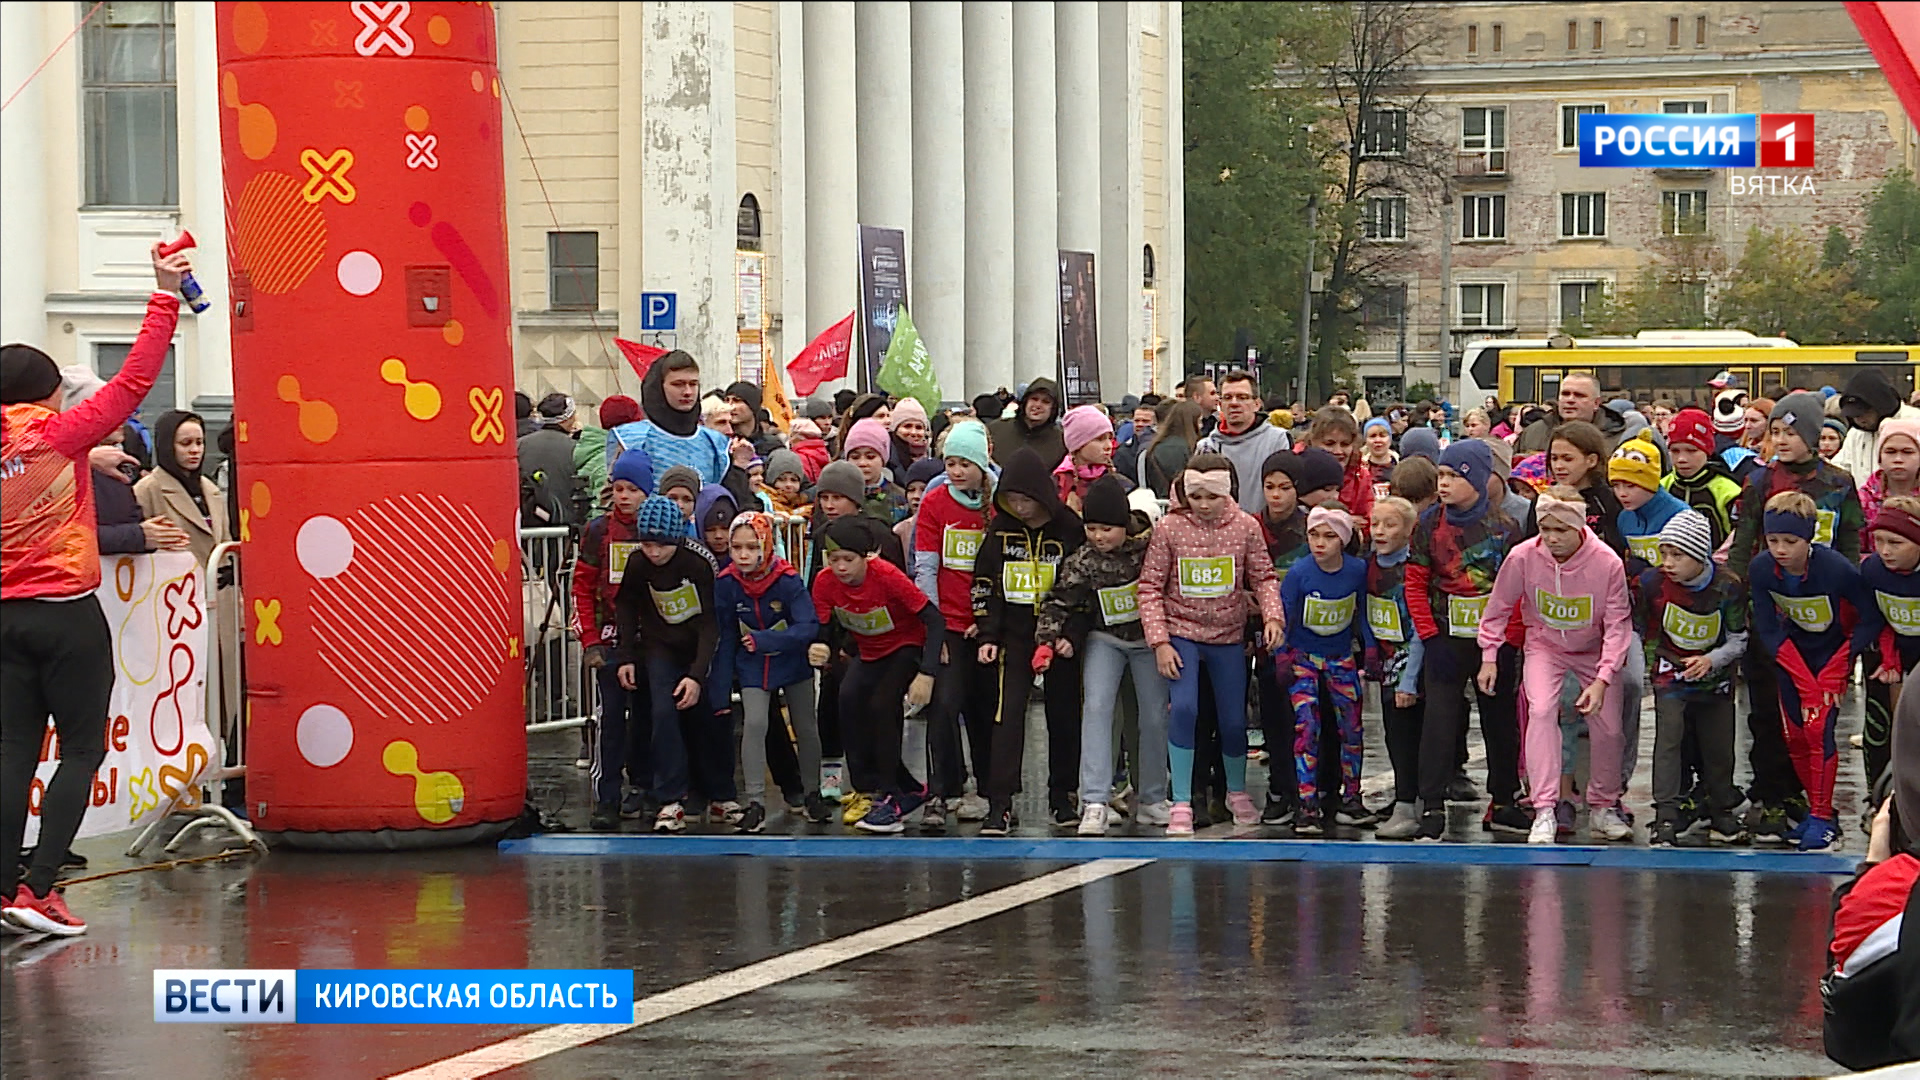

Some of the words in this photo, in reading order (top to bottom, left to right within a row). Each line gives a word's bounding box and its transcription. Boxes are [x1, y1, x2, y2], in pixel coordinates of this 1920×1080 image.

[649, 296, 669, 326] P
[956, 540, 980, 556] 68
[1191, 567, 1223, 584] 682
[1114, 595, 1136, 611] 68
[1546, 600, 1579, 619] 700
[1318, 607, 1347, 624] 702
[1461, 608, 1481, 623] 71
[1677, 619, 1709, 637] 718
